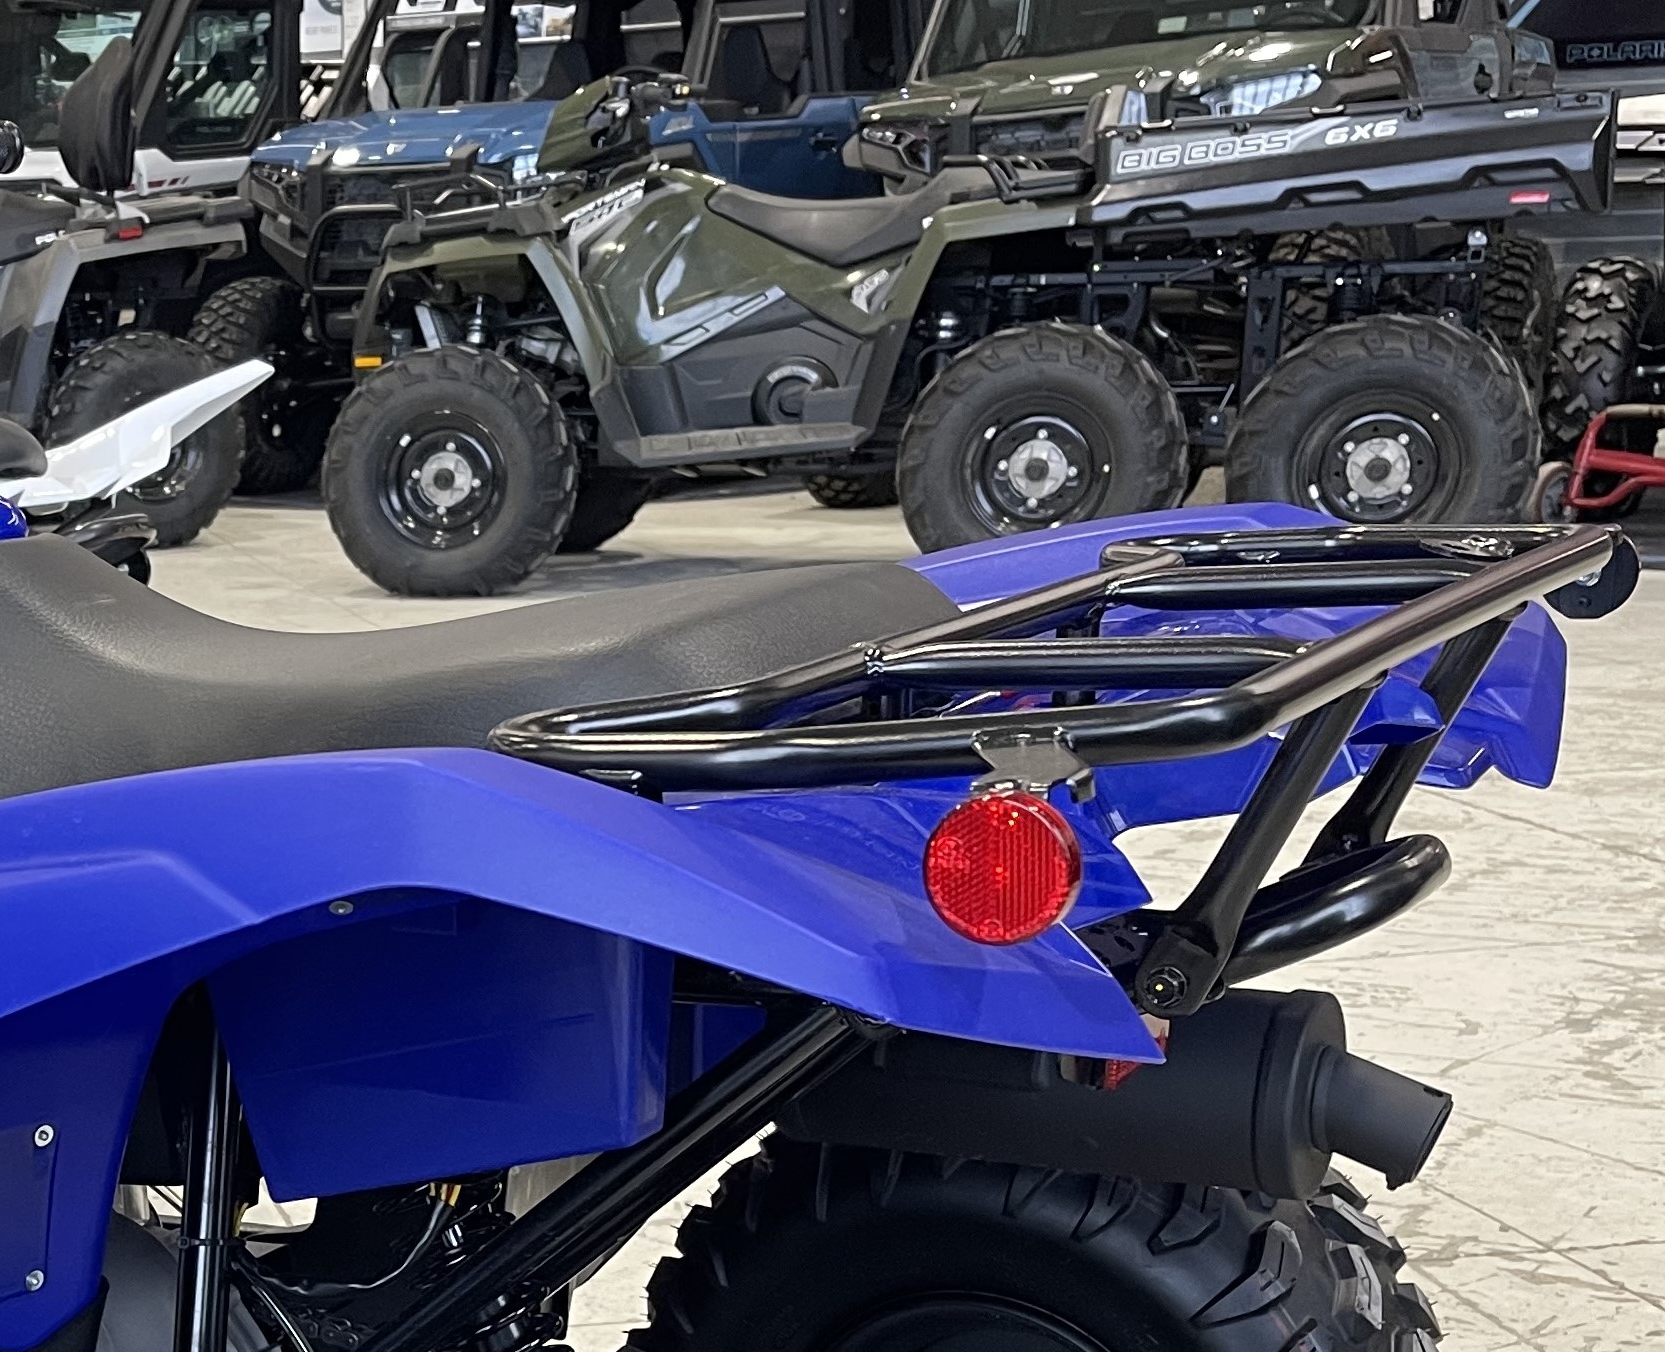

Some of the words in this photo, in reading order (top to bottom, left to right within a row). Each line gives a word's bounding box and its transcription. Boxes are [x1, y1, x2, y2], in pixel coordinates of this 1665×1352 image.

[1566, 40, 1665, 63] POLARI
[1116, 145, 1182, 173] BIG
[1184, 130, 1292, 164] BOSS
